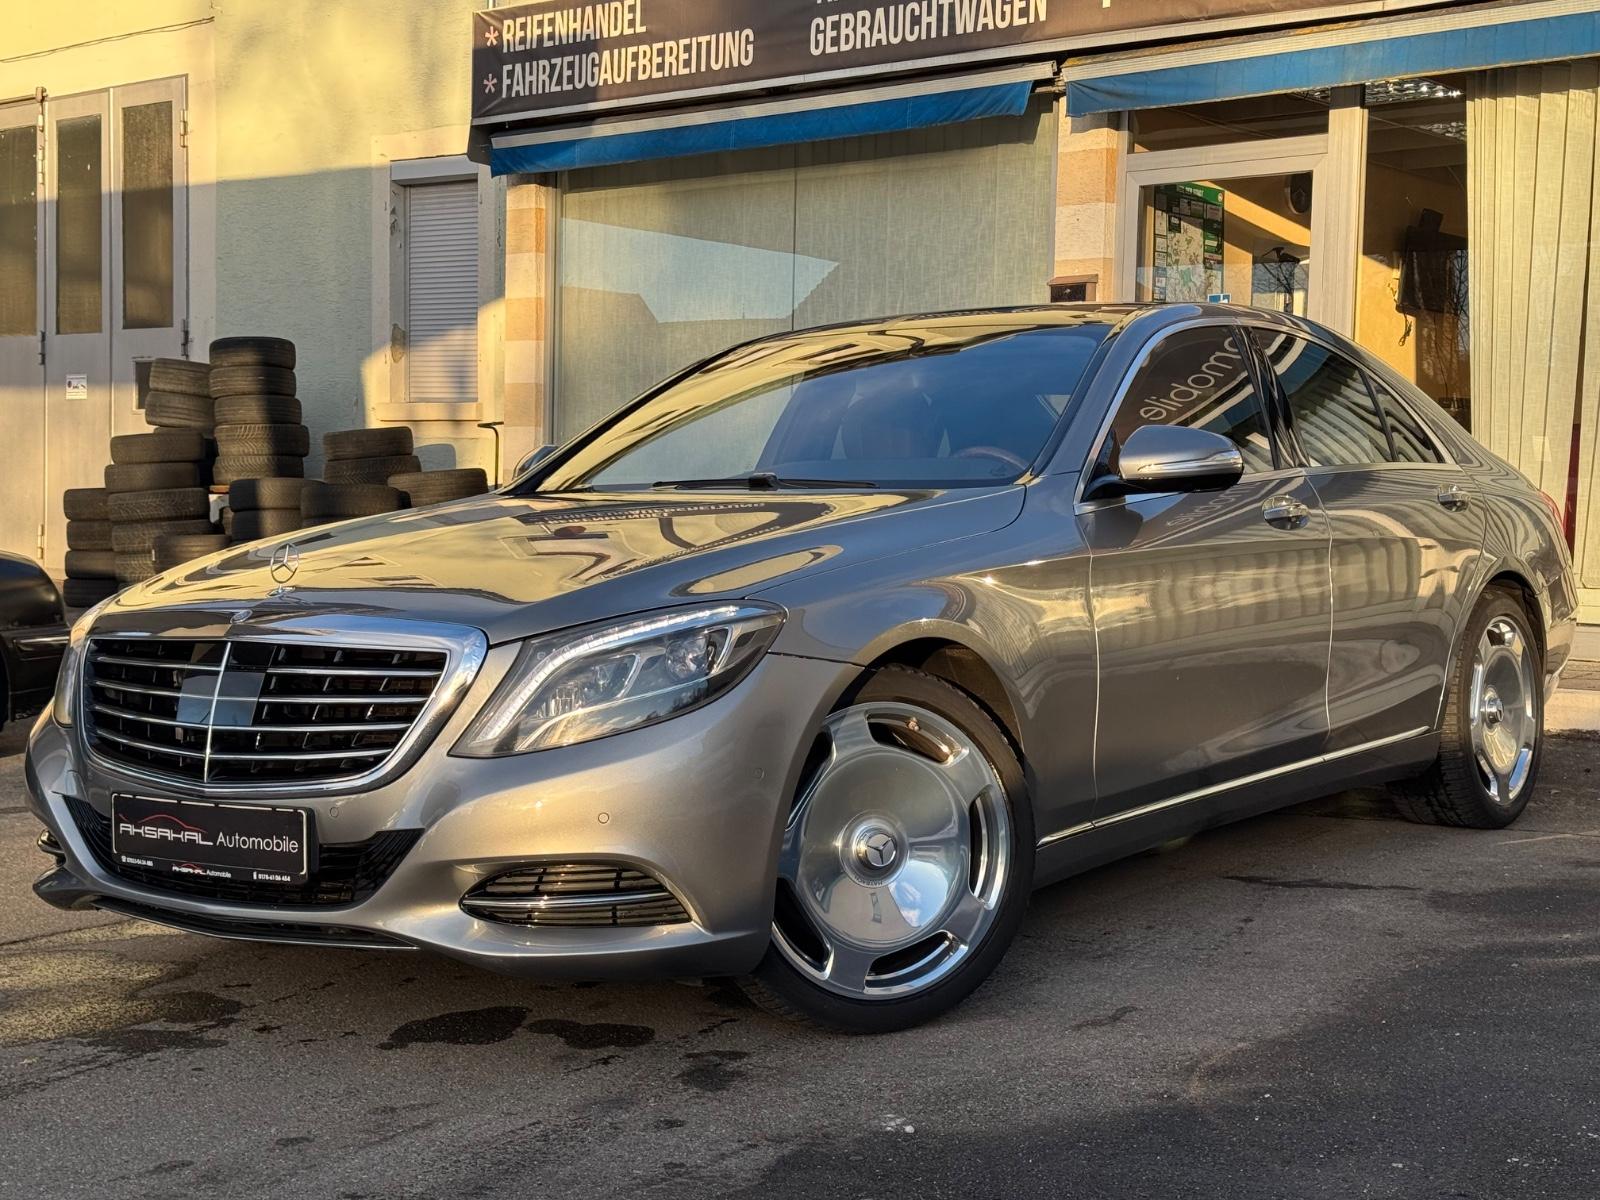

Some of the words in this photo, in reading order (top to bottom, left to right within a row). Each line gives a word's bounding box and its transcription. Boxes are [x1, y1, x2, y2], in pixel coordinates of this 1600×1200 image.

[502, 0, 647, 53] REIFENHANDEL
[809, 0, 1048, 57] GEBRAUCHTWAGEN
[501, 28, 755, 99] FAHRZEUGAUFBEREITUNG
[216, 832, 299, 853] Automobile
